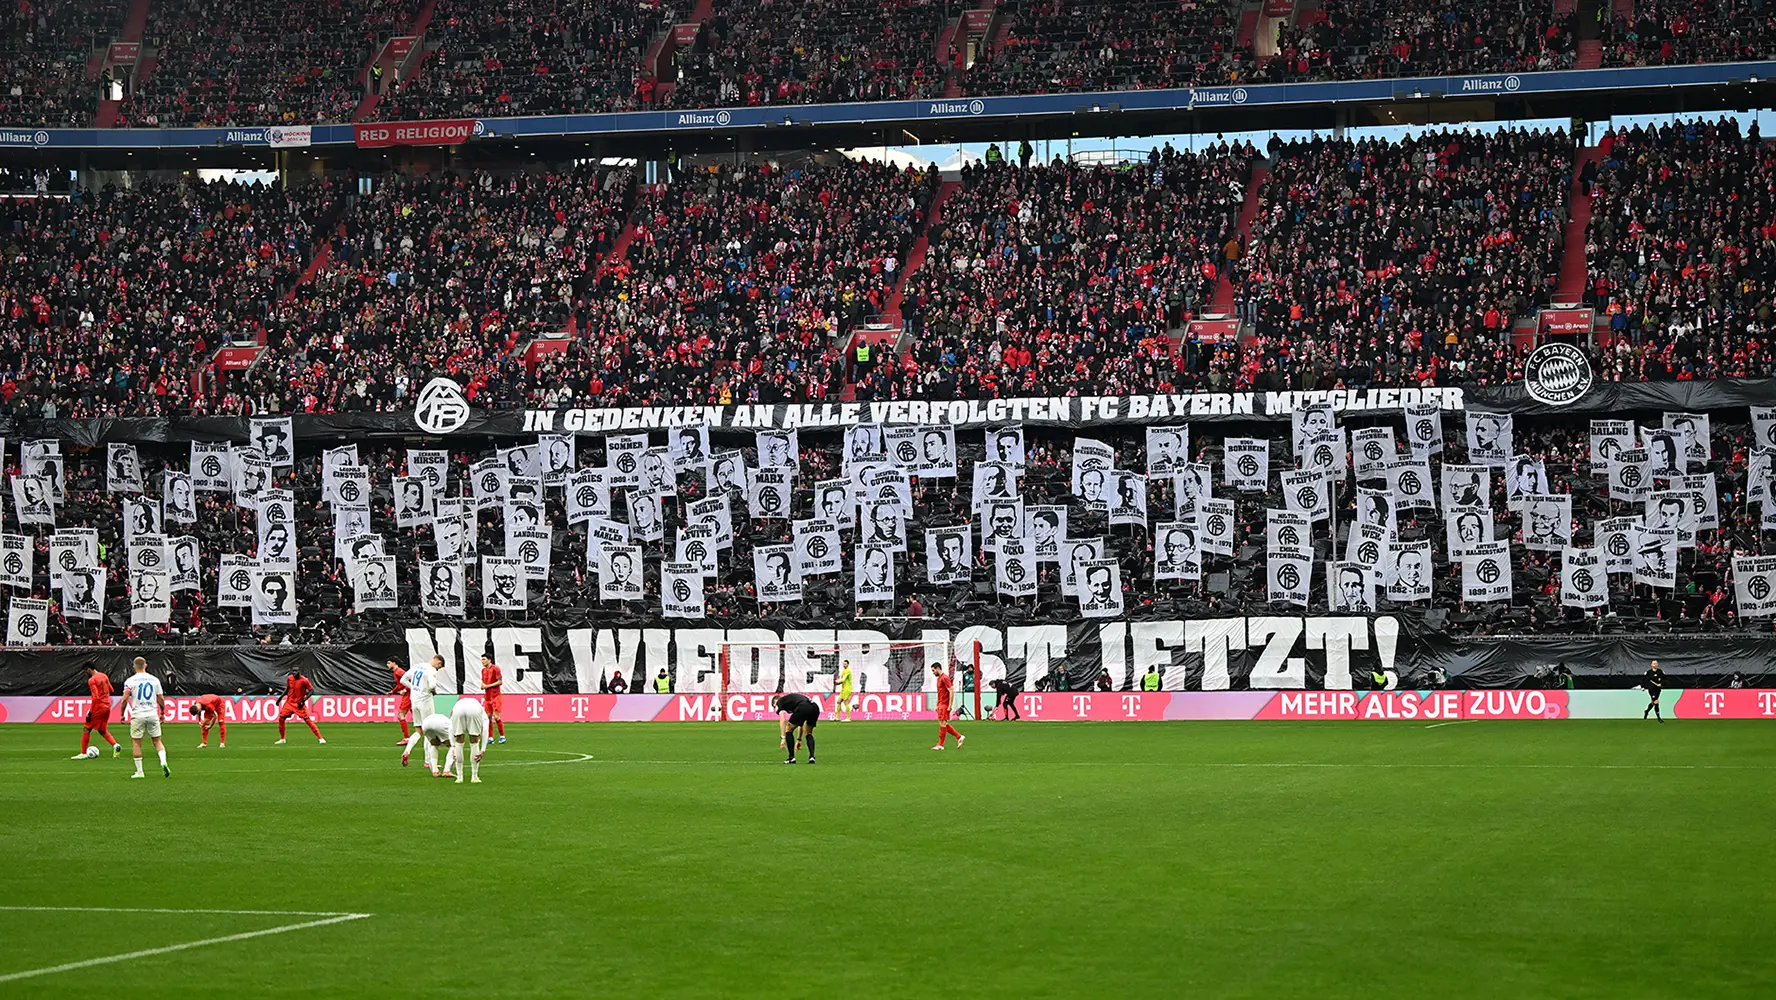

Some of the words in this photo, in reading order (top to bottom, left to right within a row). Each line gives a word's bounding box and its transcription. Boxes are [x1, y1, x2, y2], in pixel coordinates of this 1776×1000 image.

[1462, 79, 1502, 90] Allianz
[1190, 91, 1229, 102] Allianz
[930, 103, 968, 114] Allianz
[678, 114, 714, 124] Allianz
[226, 131, 262, 141] Allianz
[360, 130, 389, 140] RED
[396, 126, 468, 140] RELIGION
[1542, 346, 1584, 366] BAYERN
[522, 410, 552, 432] IN
[564, 404, 727, 432] GEDENKEN
[731, 404, 778, 428] AN
[783, 402, 865, 428] ALLE
[869, 396, 1071, 426] VERFOLGTEN
[1081, 394, 1119, 421] FC
[1128, 390, 1254, 418] BAYERN
[1266, 387, 1464, 415] MITGLIEDER
[1591, 427, 1628, 436] RAILING
[609, 442, 643, 450] SOMMER
[414, 456, 446, 464] HIRSCH
[1614, 452, 1649, 464] SCHILD
[572, 474, 602, 486] PORIES
[756, 474, 784, 484] MARX
[870, 476, 905, 486] GUTMANN
[1286, 472, 1323, 486] PFEIFFER
[692, 504, 724, 516] RAILING
[1202, 506, 1234, 516] MARCUSE
[800, 524, 834, 534] KLOPFER
[513, 531, 548, 539] LANDAUER
[594, 529, 624, 542] MAHLER
[3, 541, 24, 550] REISS
[1002, 545, 1024, 556] UCKO
[604, 584, 620, 592] 1921
[12, 602, 46, 610] NEUBURGER
[406, 628, 543, 694] NIE
[568, 628, 892, 694] WIEDER
[922, 624, 1067, 693] IST
[1094, 616, 1399, 692] JETZT!
[412, 670, 424, 687] 19
[138, 682, 154, 700] 10
[1281, 692, 1356, 715] MEHR
[1365, 692, 1420, 719] ALS
[1423, 692, 1458, 719] JE
